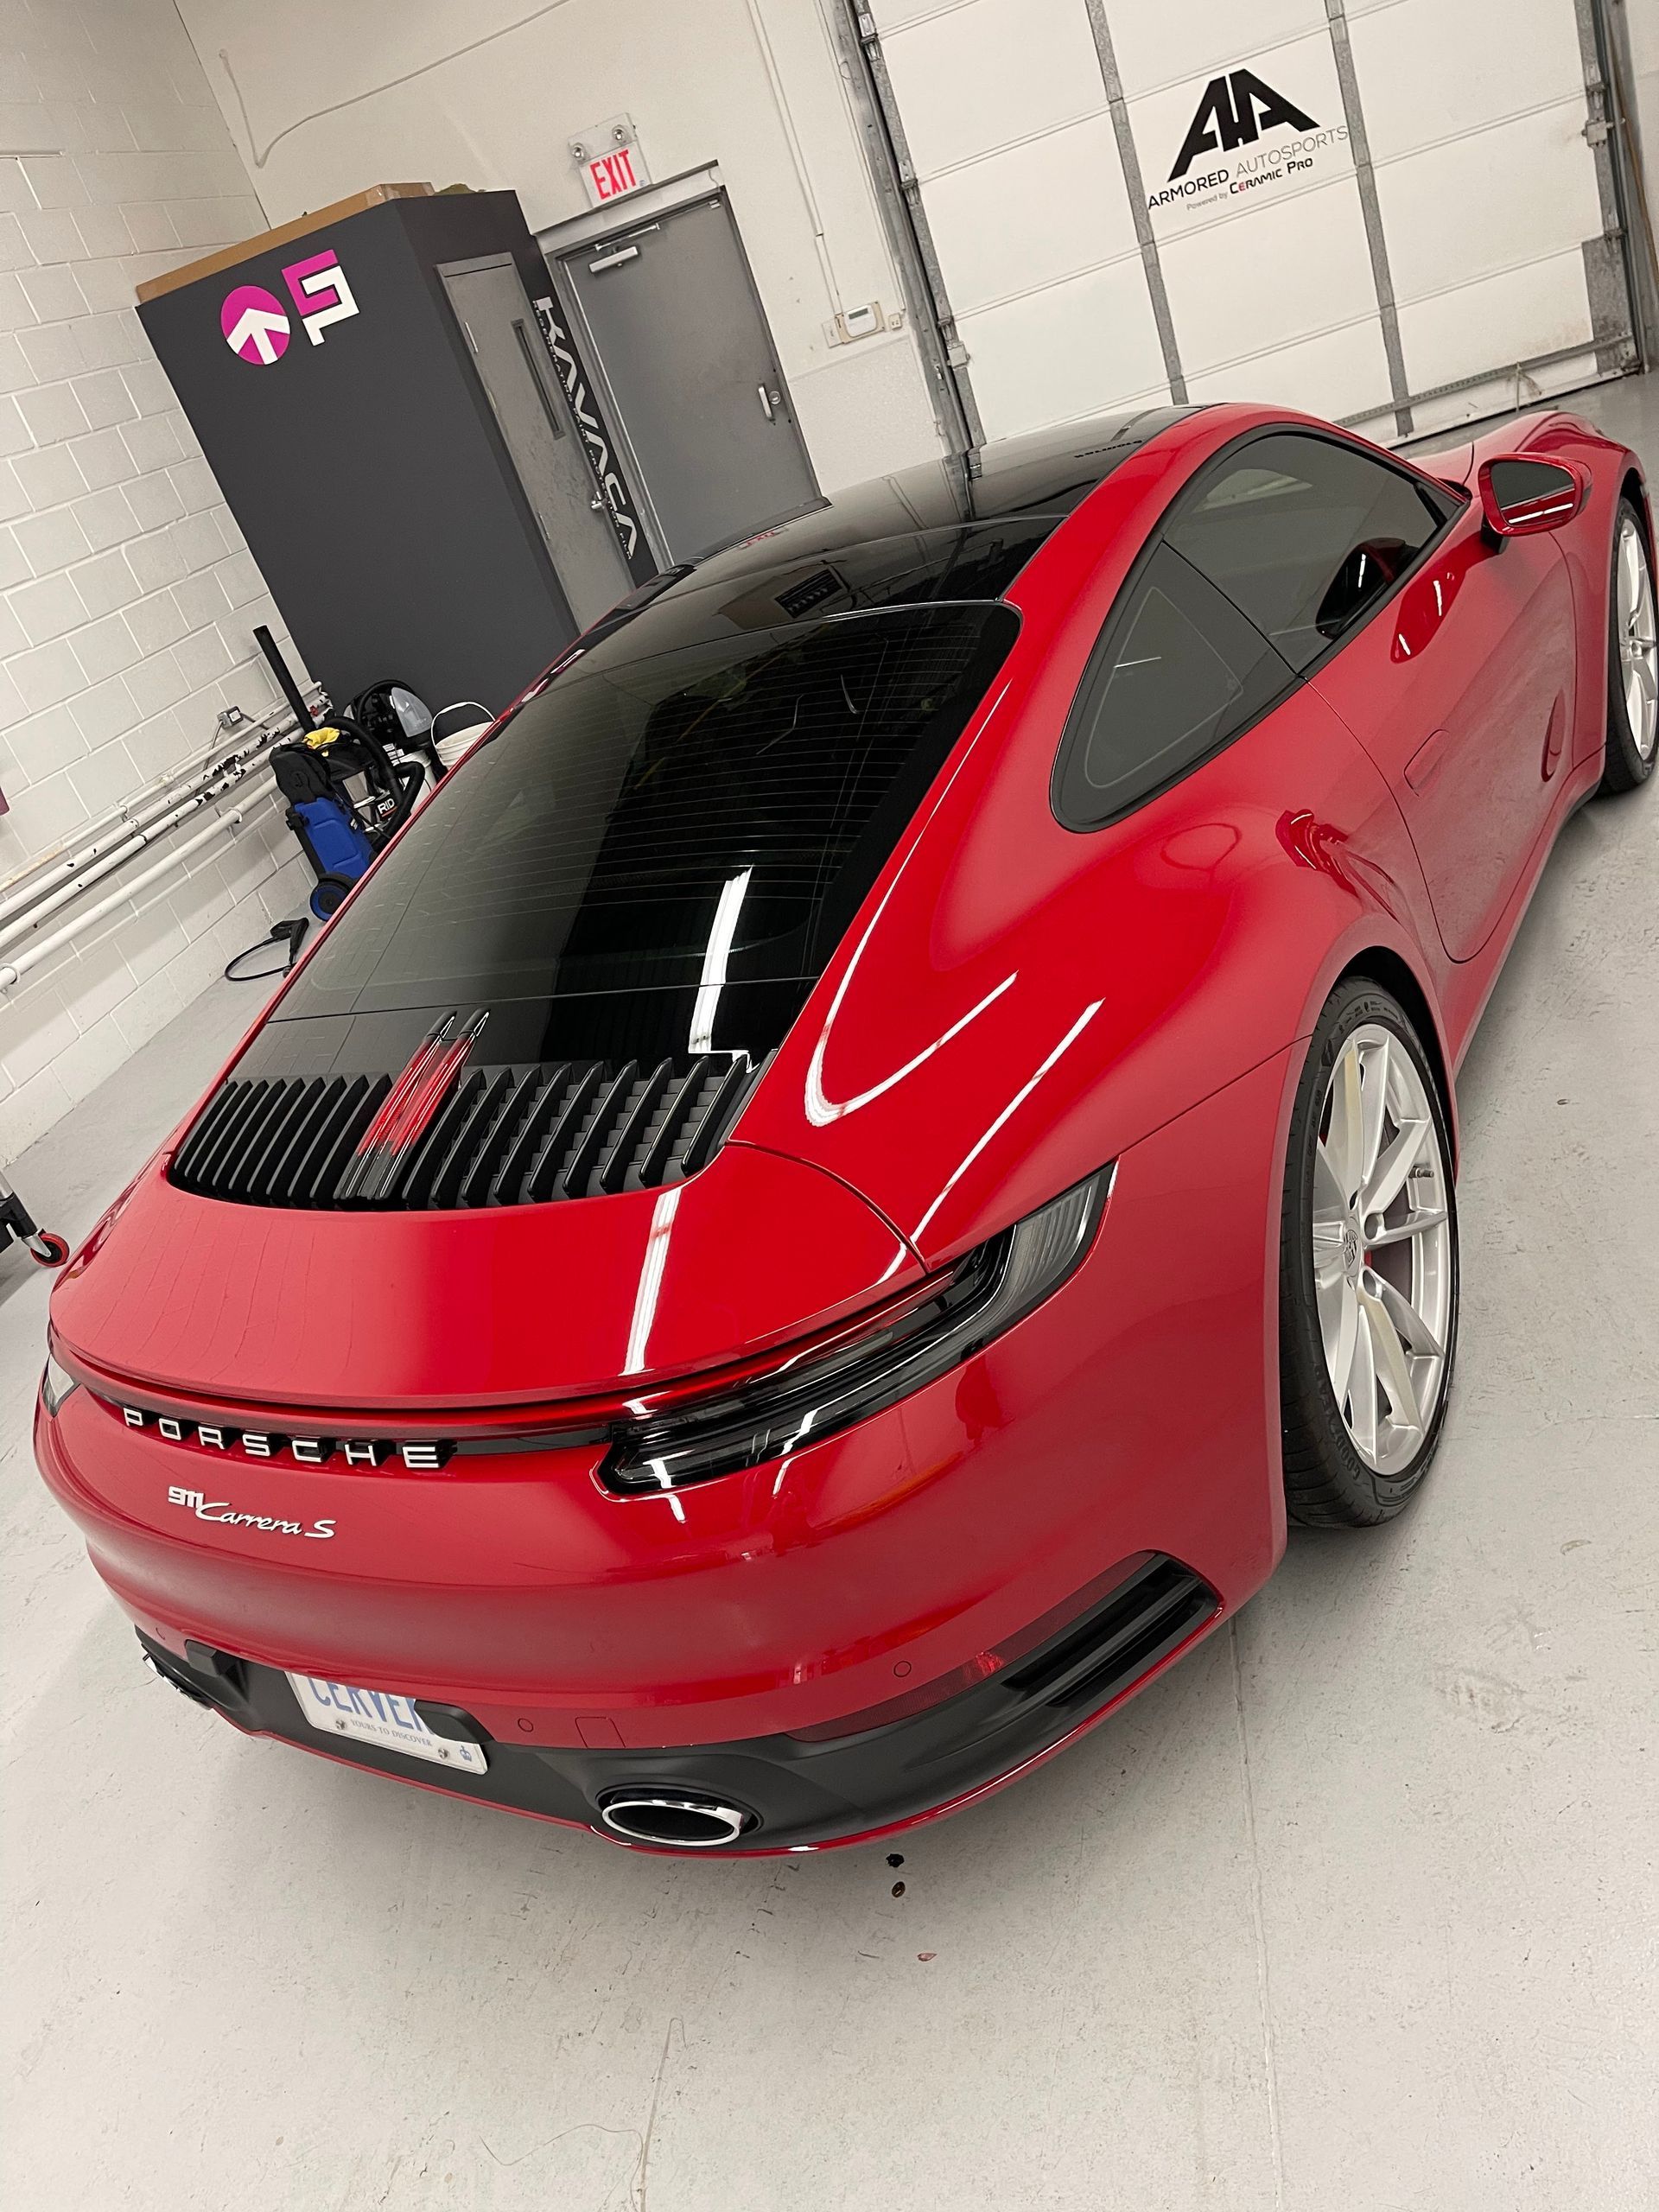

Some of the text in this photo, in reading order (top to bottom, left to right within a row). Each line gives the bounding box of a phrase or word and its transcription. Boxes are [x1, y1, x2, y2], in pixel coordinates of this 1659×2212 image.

[590, 149, 637, 200] EXIT
[1148, 125, 1349, 210] ARMORED AUTOSPORTS
[1186, 157, 1313, 211] Powered by CERAMIC PRO
[536, 296, 637, 556] KAVACA
[124, 1407, 441, 1468] PORSCHE
[168, 1485, 337, 1539] 911 Carrera S
[350, 1719, 433, 1747] YOURS TO DISCOVER
